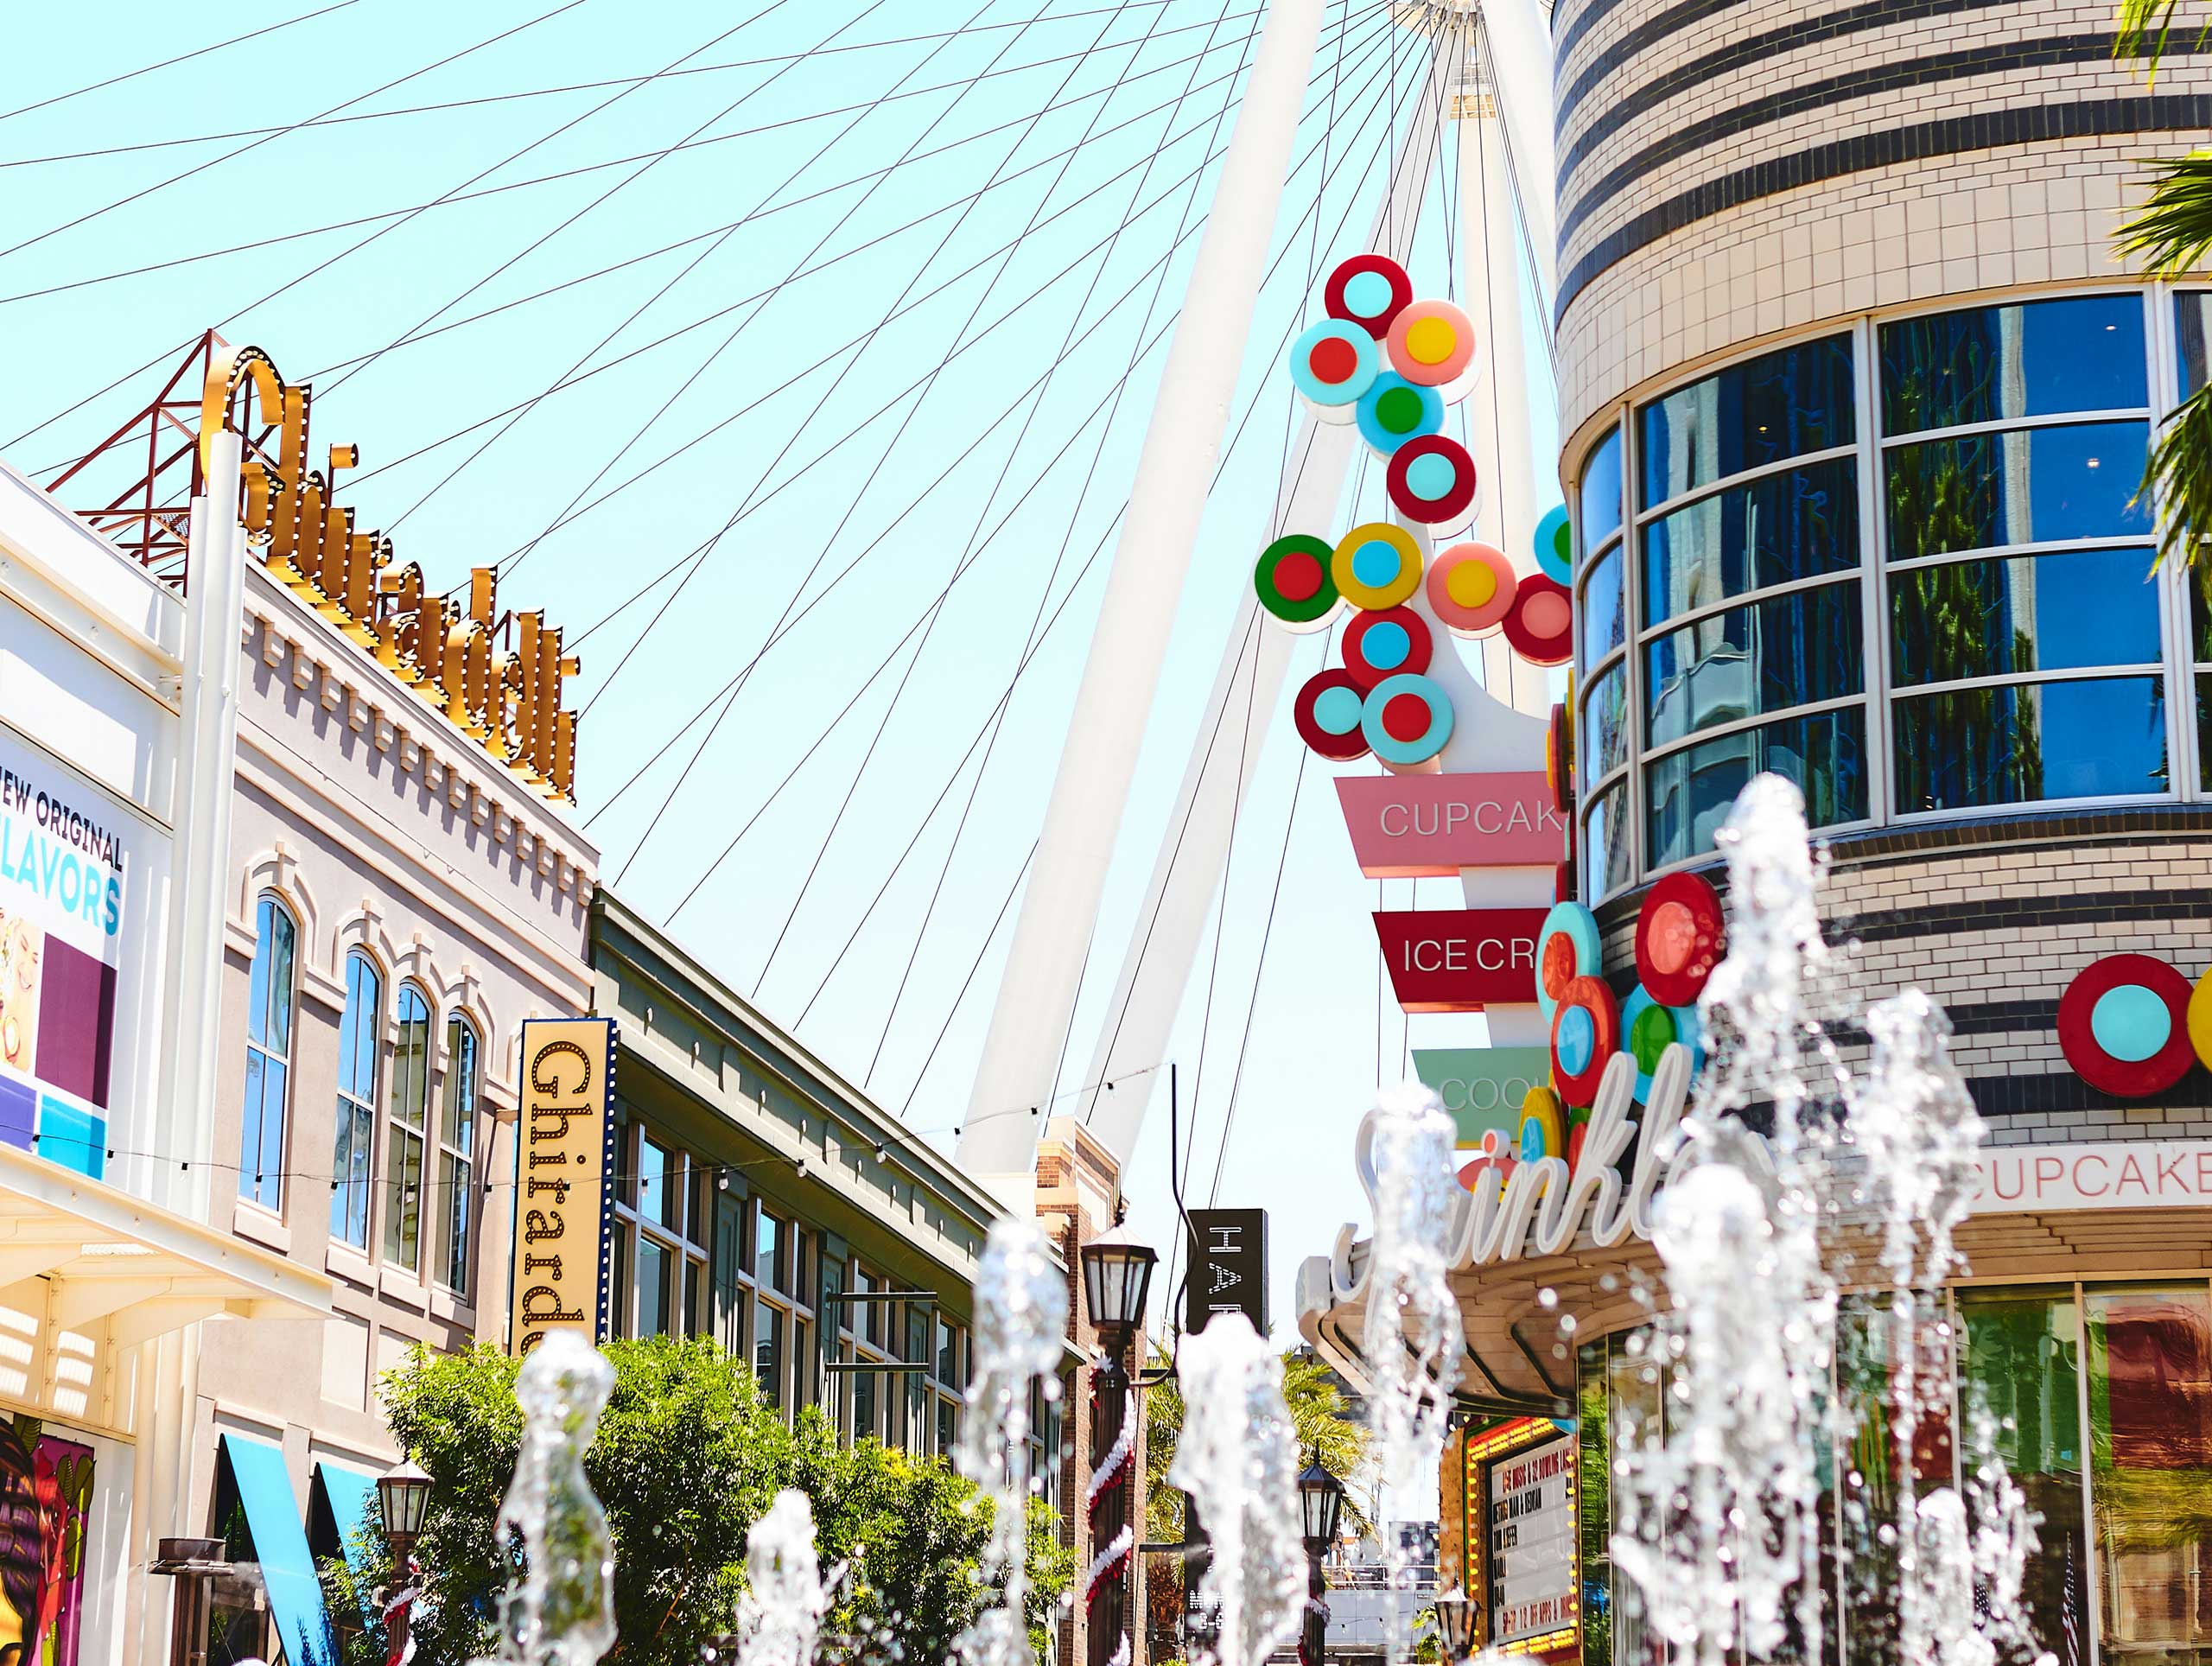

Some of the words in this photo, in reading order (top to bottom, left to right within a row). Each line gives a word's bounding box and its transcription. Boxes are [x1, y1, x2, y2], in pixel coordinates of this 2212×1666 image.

[0, 766, 32, 815] EW
[36, 791, 123, 873] ORIGINAL
[1380, 800, 1563, 836] CUPCAK
[0, 812, 121, 937] LAVORS
[1403, 938, 1467, 972] ICE
[1439, 1076, 1540, 1112] COO
[1973, 1152, 2212, 1200] UPCAKE
